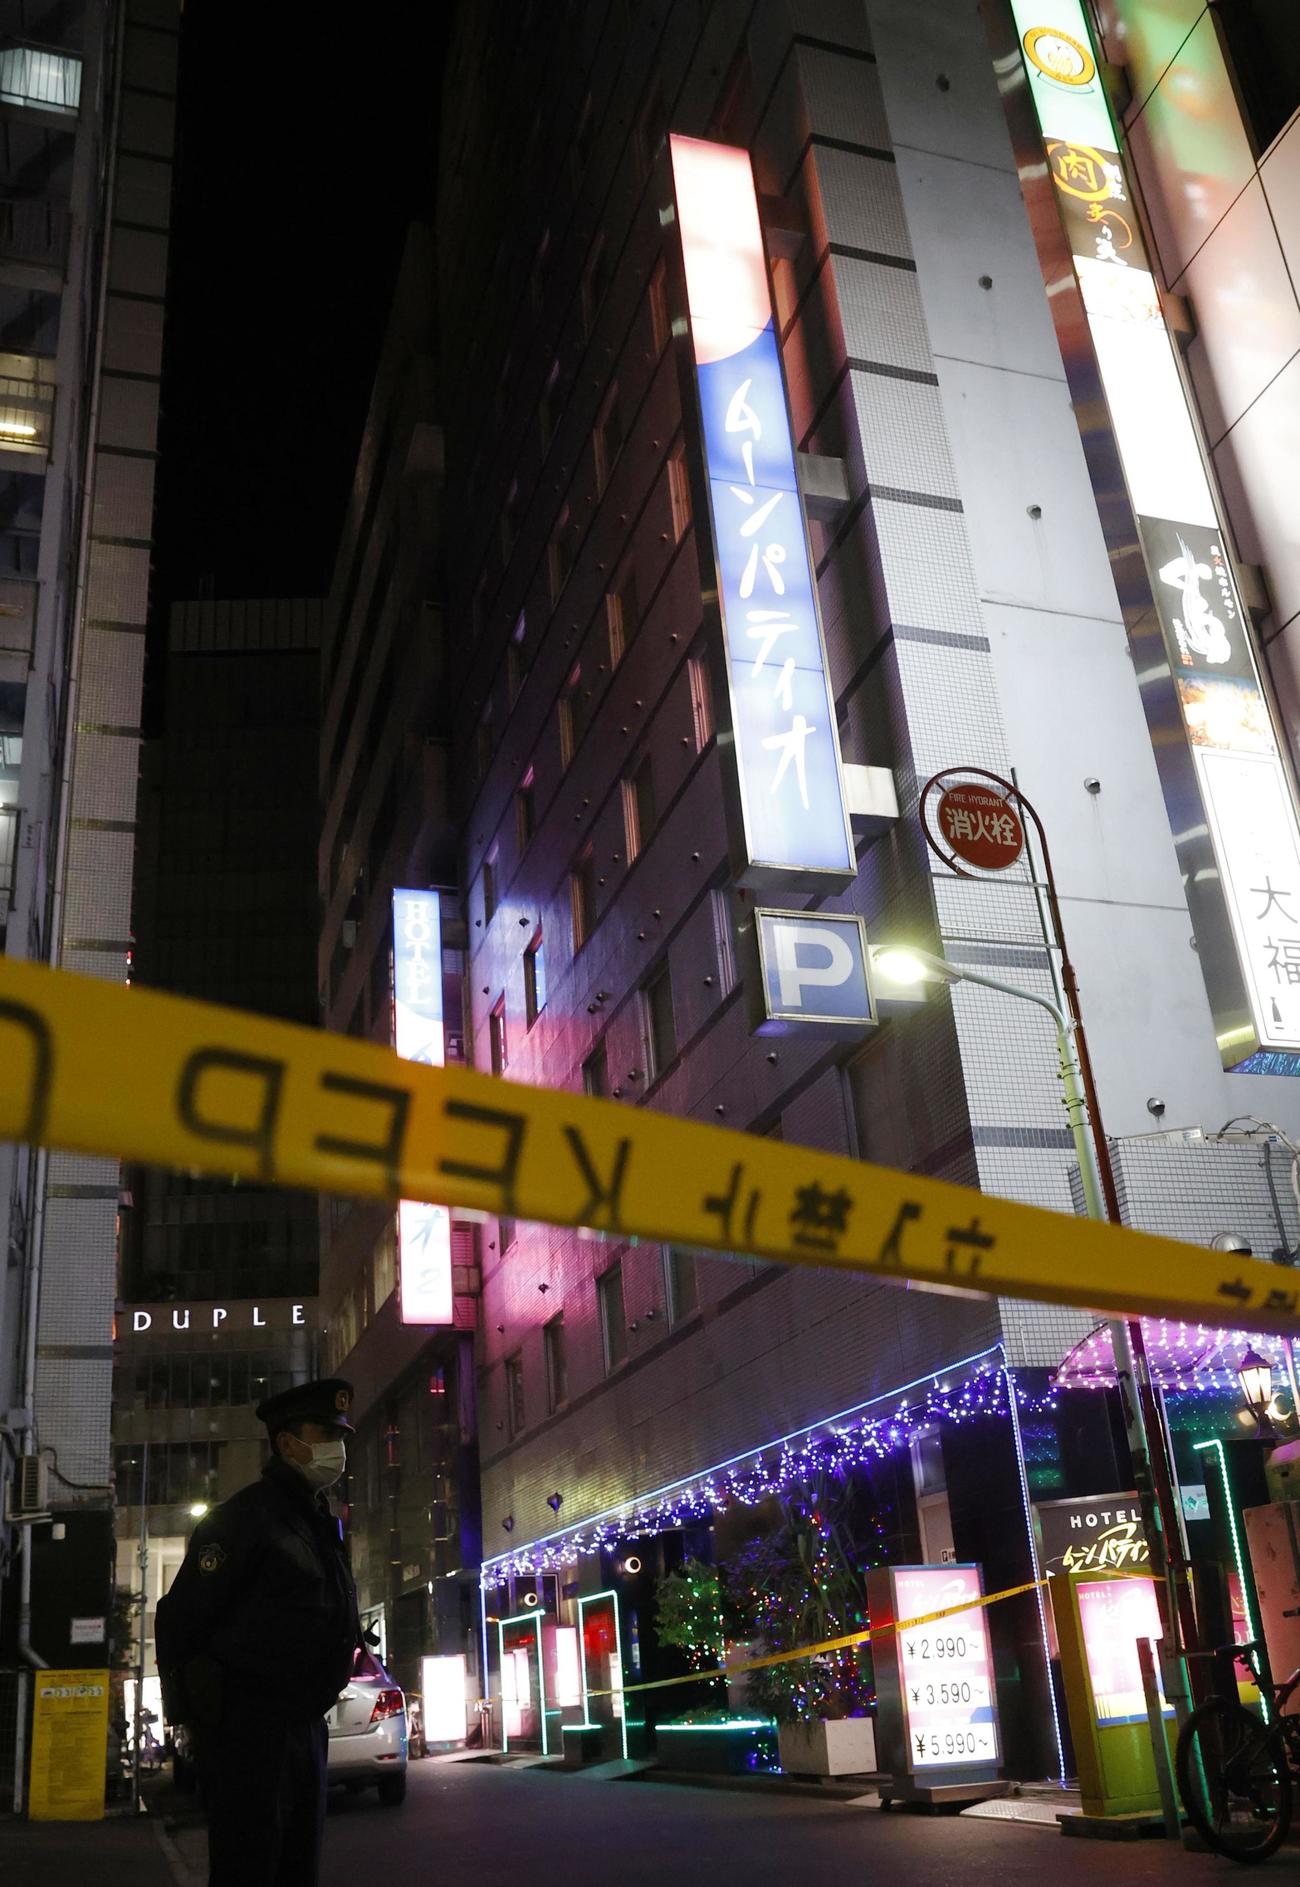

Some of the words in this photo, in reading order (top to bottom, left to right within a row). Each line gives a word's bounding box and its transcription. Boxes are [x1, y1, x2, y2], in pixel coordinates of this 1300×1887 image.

[724, 377, 817, 811] ムーンパティオ
[945, 807, 1018, 847] 消火栓
[403, 899, 432, 1006] HOTEL
[772, 924, 854, 1007] P
[132, 1304, 306, 1332] DUPLE
[1069, 1508, 1142, 1529] HOTEL
[1078, 1591, 1106, 1601] HOTEL
